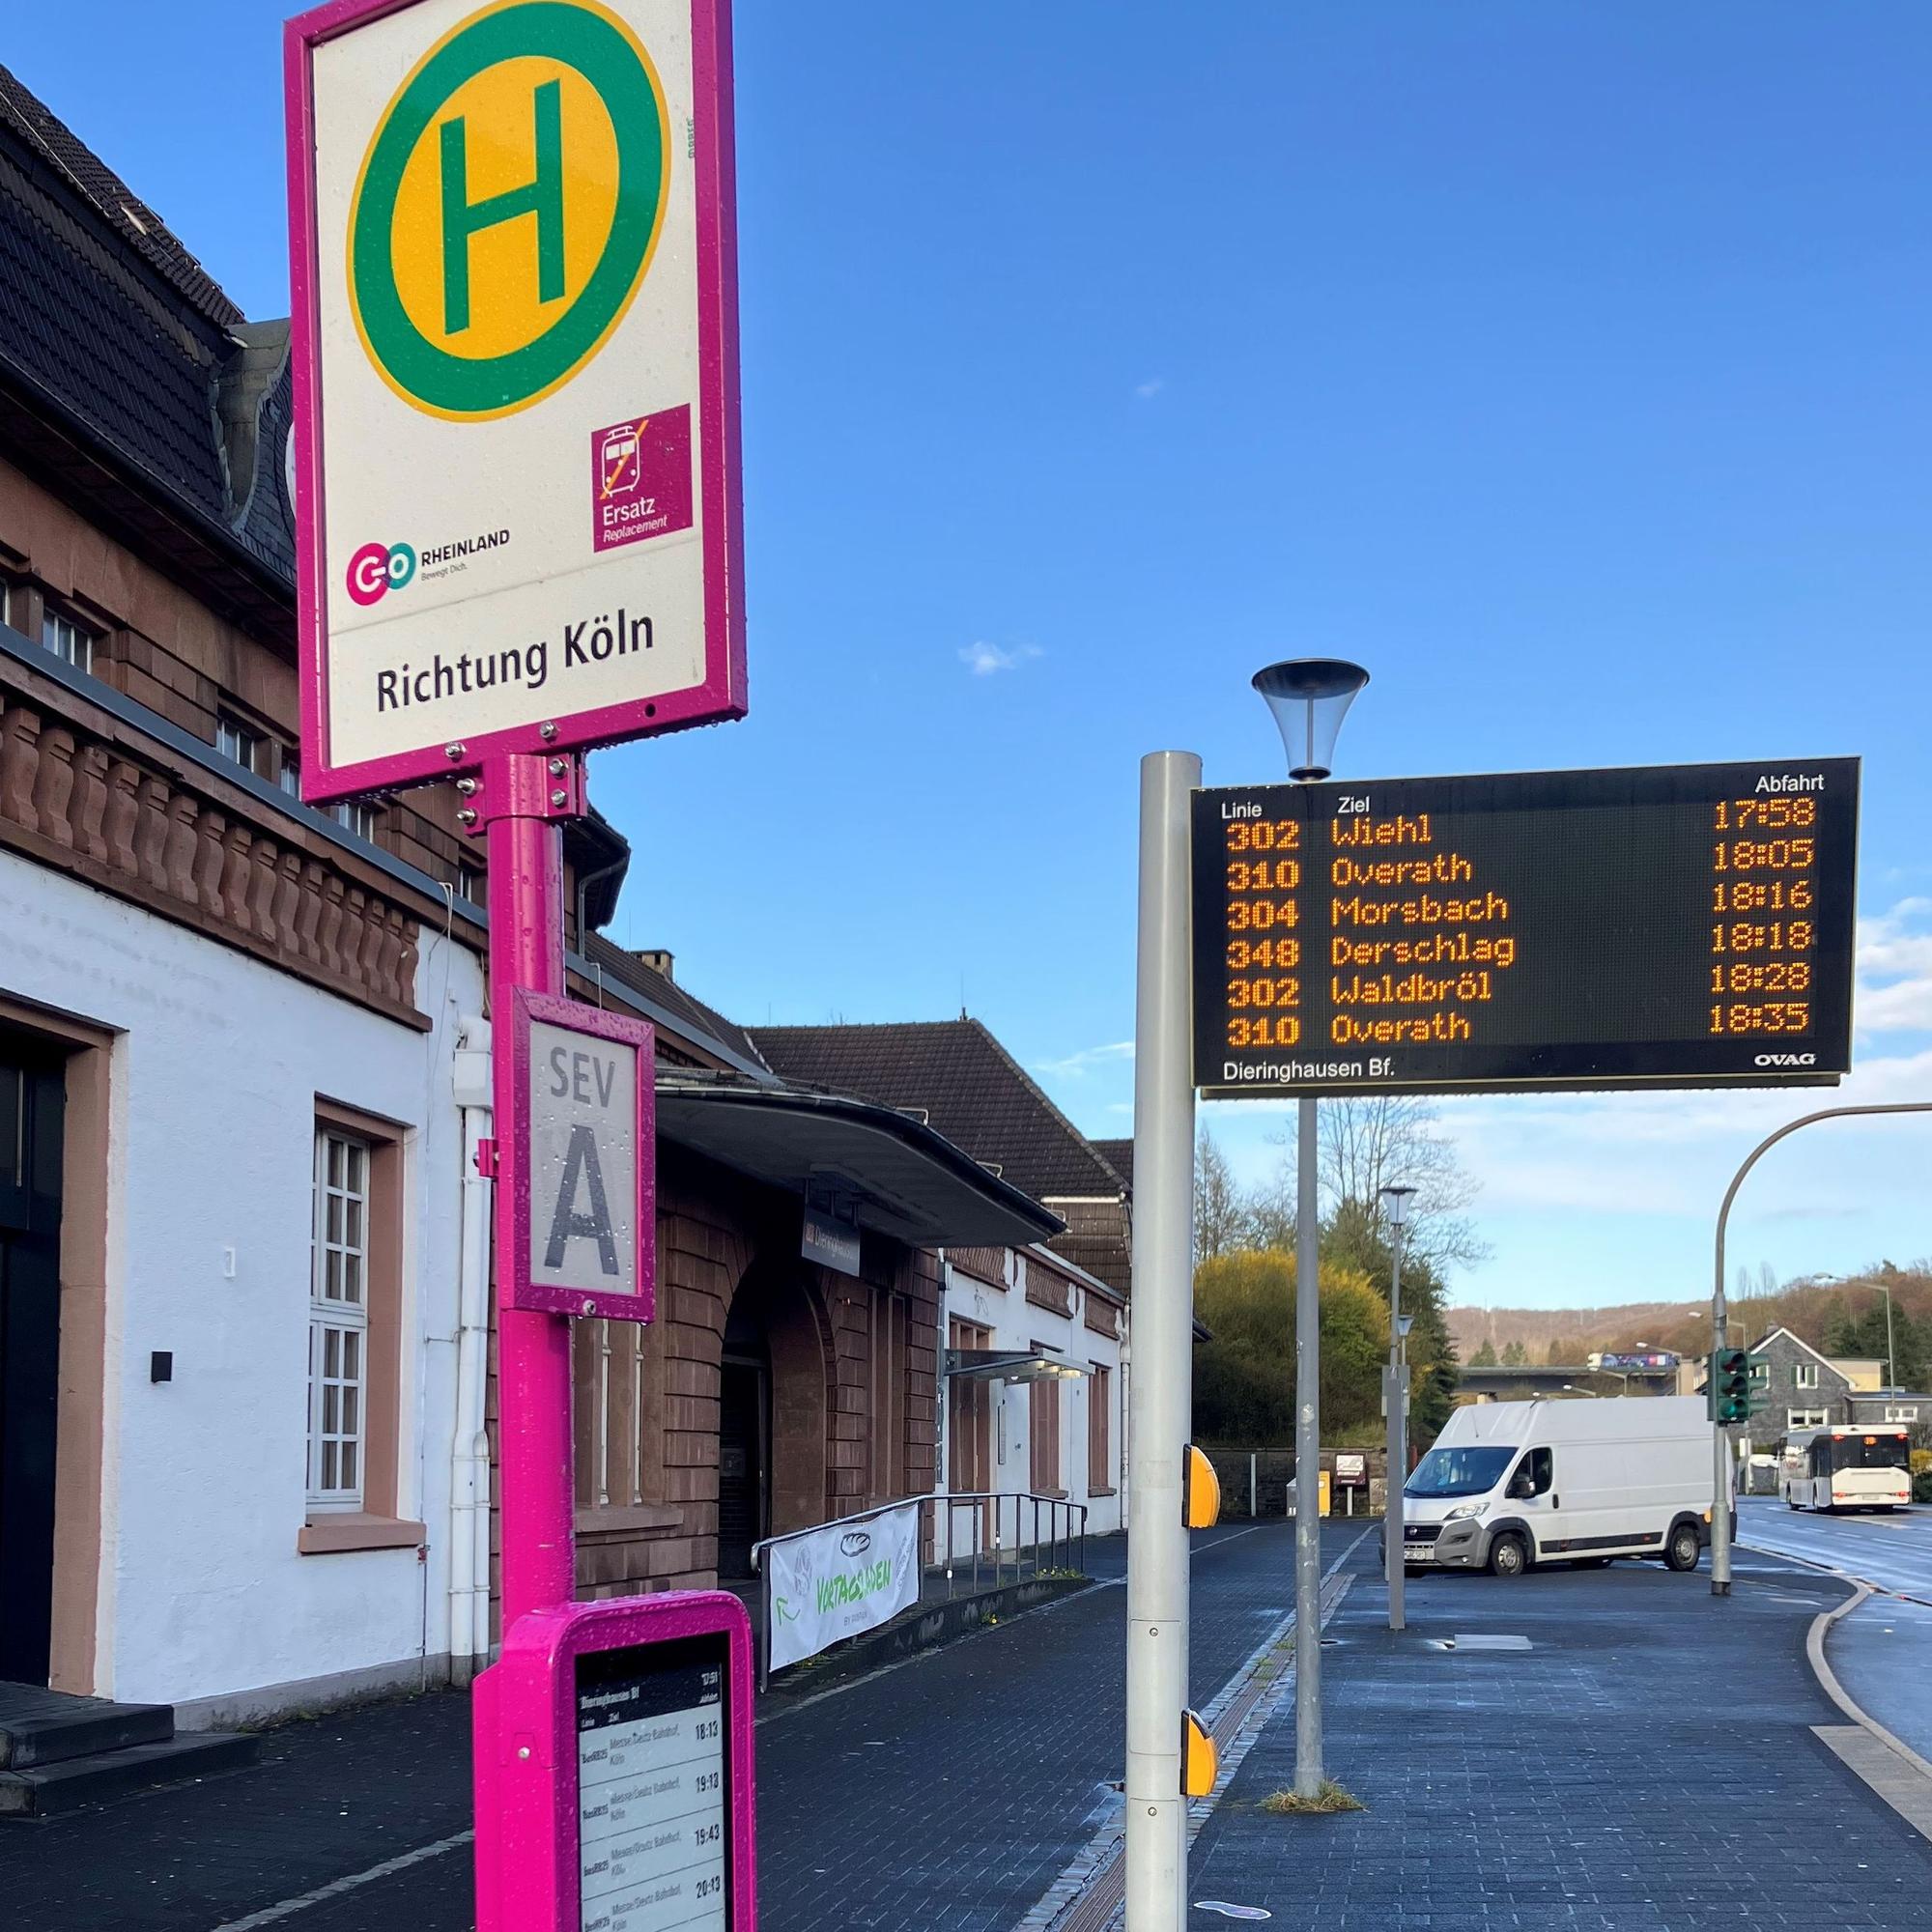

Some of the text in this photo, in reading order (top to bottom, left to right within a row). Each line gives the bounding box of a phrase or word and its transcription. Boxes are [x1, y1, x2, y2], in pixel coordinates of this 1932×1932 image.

[440, 78, 565, 335] H
[603, 497, 655, 526] Ersatz
[603, 514, 668, 542] Replacement
[421, 529, 510, 566] RHEINLAND
[421, 567, 448, 581] Bewegt
[378, 609, 653, 712] Richtung Köln
[1221, 774, 1825, 819] Linie Ziel Abfahrt
[1227, 798, 1816, 850] 302 Wiehl 17:58
[1227, 838, 1814, 891] 310 Overath 18:05
[1227, 880, 1812, 930] 304 Morsbach 18:16
[1227, 921, 1812, 969] 348 Derschlag 18:18
[1227, 962, 1810, 1008] 302 Waldbröl 18:28
[1227, 1003, 1809, 1047] 310 Overath 18:35
[550, 1046, 615, 1108] SEV
[1224, 1058, 1395, 1082] Dieringhausen Bf.
[1754, 1053, 1816, 1066] OVAG
[544, 1123, 619, 1275] A
[696, 1720, 718, 1740] 18:13
[696, 1772, 719, 1793] 19:13
[695, 1824, 720, 1846] 19:43
[696, 1876, 721, 1899] 20:13
